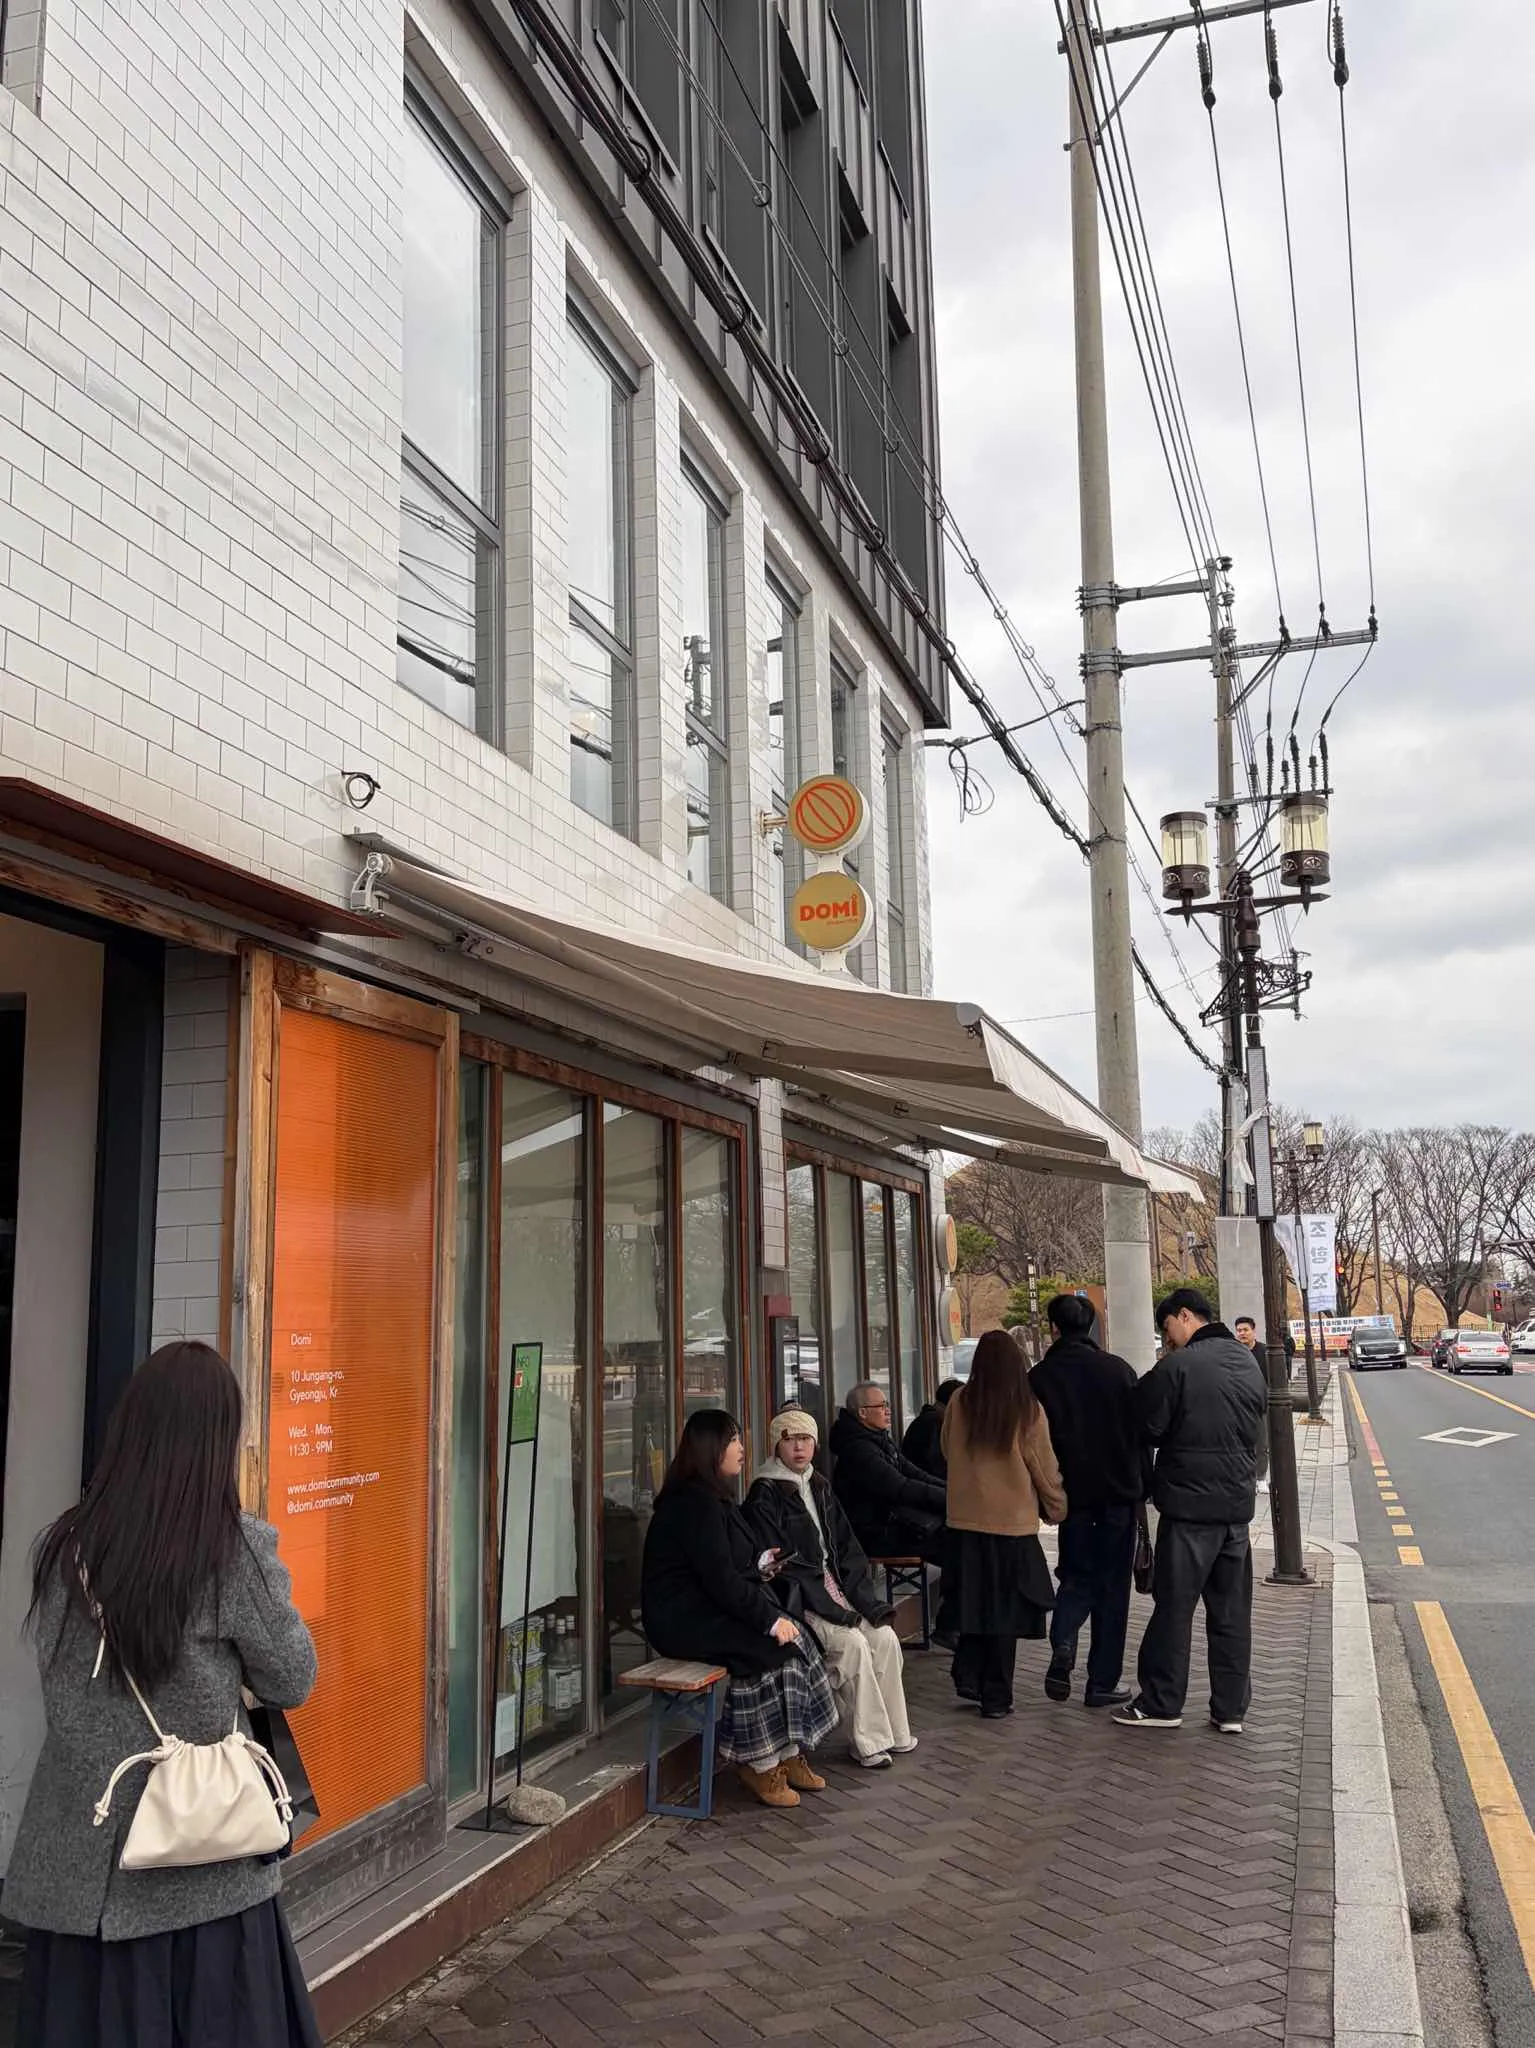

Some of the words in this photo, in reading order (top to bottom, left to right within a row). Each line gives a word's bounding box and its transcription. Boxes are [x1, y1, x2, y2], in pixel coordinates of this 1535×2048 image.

[290, 1332, 312, 1346] Domi
[291, 1369, 300, 1383] 10
[329, 1386, 338, 1399] Kr
[288, 1424, 309, 1439] Wed.
[288, 1442, 310, 1457] 11:30
[315, 1440, 333, 1454] 9PM
[287, 1471, 380, 1495] www.domicommunity.com
[287, 1492, 354, 1514] @domi.community
